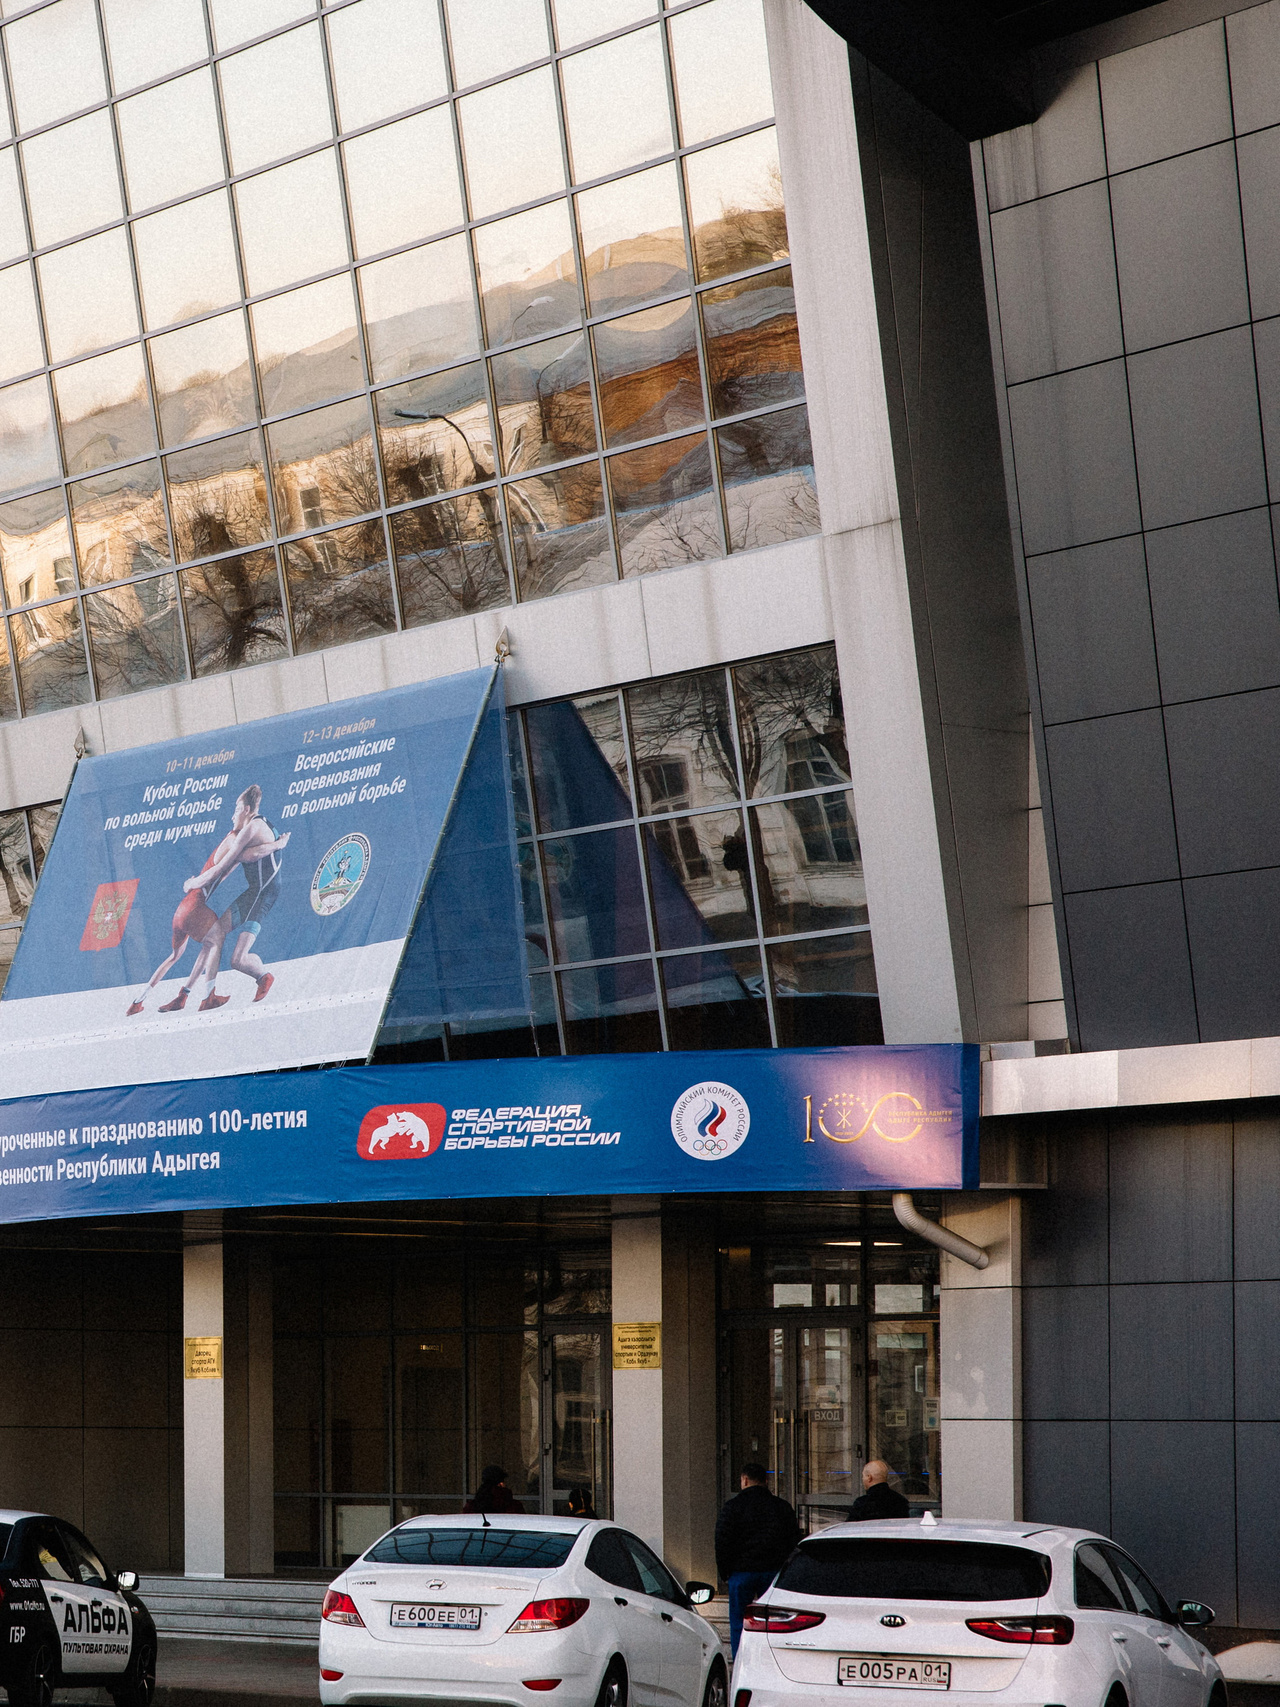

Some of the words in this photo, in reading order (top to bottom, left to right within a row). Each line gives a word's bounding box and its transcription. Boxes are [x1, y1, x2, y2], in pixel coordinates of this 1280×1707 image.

[333, 717, 376, 740] декабря
[194, 748, 235, 770] декабря
[294, 737, 396, 772] Всероссийские
[142, 781, 182, 806] Кубок
[182, 774, 229, 795] России
[288, 763, 382, 797] соревнования
[104, 816, 121, 831] по
[122, 801, 176, 828] вольной
[177, 793, 223, 819] борьбе
[281, 803, 298, 819] по
[300, 786, 358, 815] вольной
[358, 775, 407, 803] борьбе
[124, 830, 163, 851] среди
[164, 820, 217, 844] мужчин
[70, 1127, 78, 1145] к
[82, 1117, 203, 1148] празднованию
[209, 1109, 307, 1134] 100-летия
[448, 1115, 592, 1136] СПОРТИВНОЙ
[451, 1104, 582, 1123] ФЕДЕРАЦИЯ
[675, 1087, 706, 1143] ОЛИМПИЙСКИЙ
[707, 1086, 741, 1107] КОМИТЕТ
[733, 1108, 746, 1141] РОССИИ
[444, 1134, 527, 1150] БОРЬБЫ
[531, 1132, 622, 1148] РОССИИ
[57, 1153, 147, 1183] Республики
[151, 1151, 220, 1176] Адыгея
[814, 1410, 841, 1421] ВХОД
[9, 1626, 26, 1643] ГБР
[63, 1603, 129, 1635] АЛЬФА
[883, 1616, 902, 1625] KIA
[63, 1643, 103, 1654] ПУЛЬТОВАЯ
[104, 1643, 129, 1655] ОХРАНА
